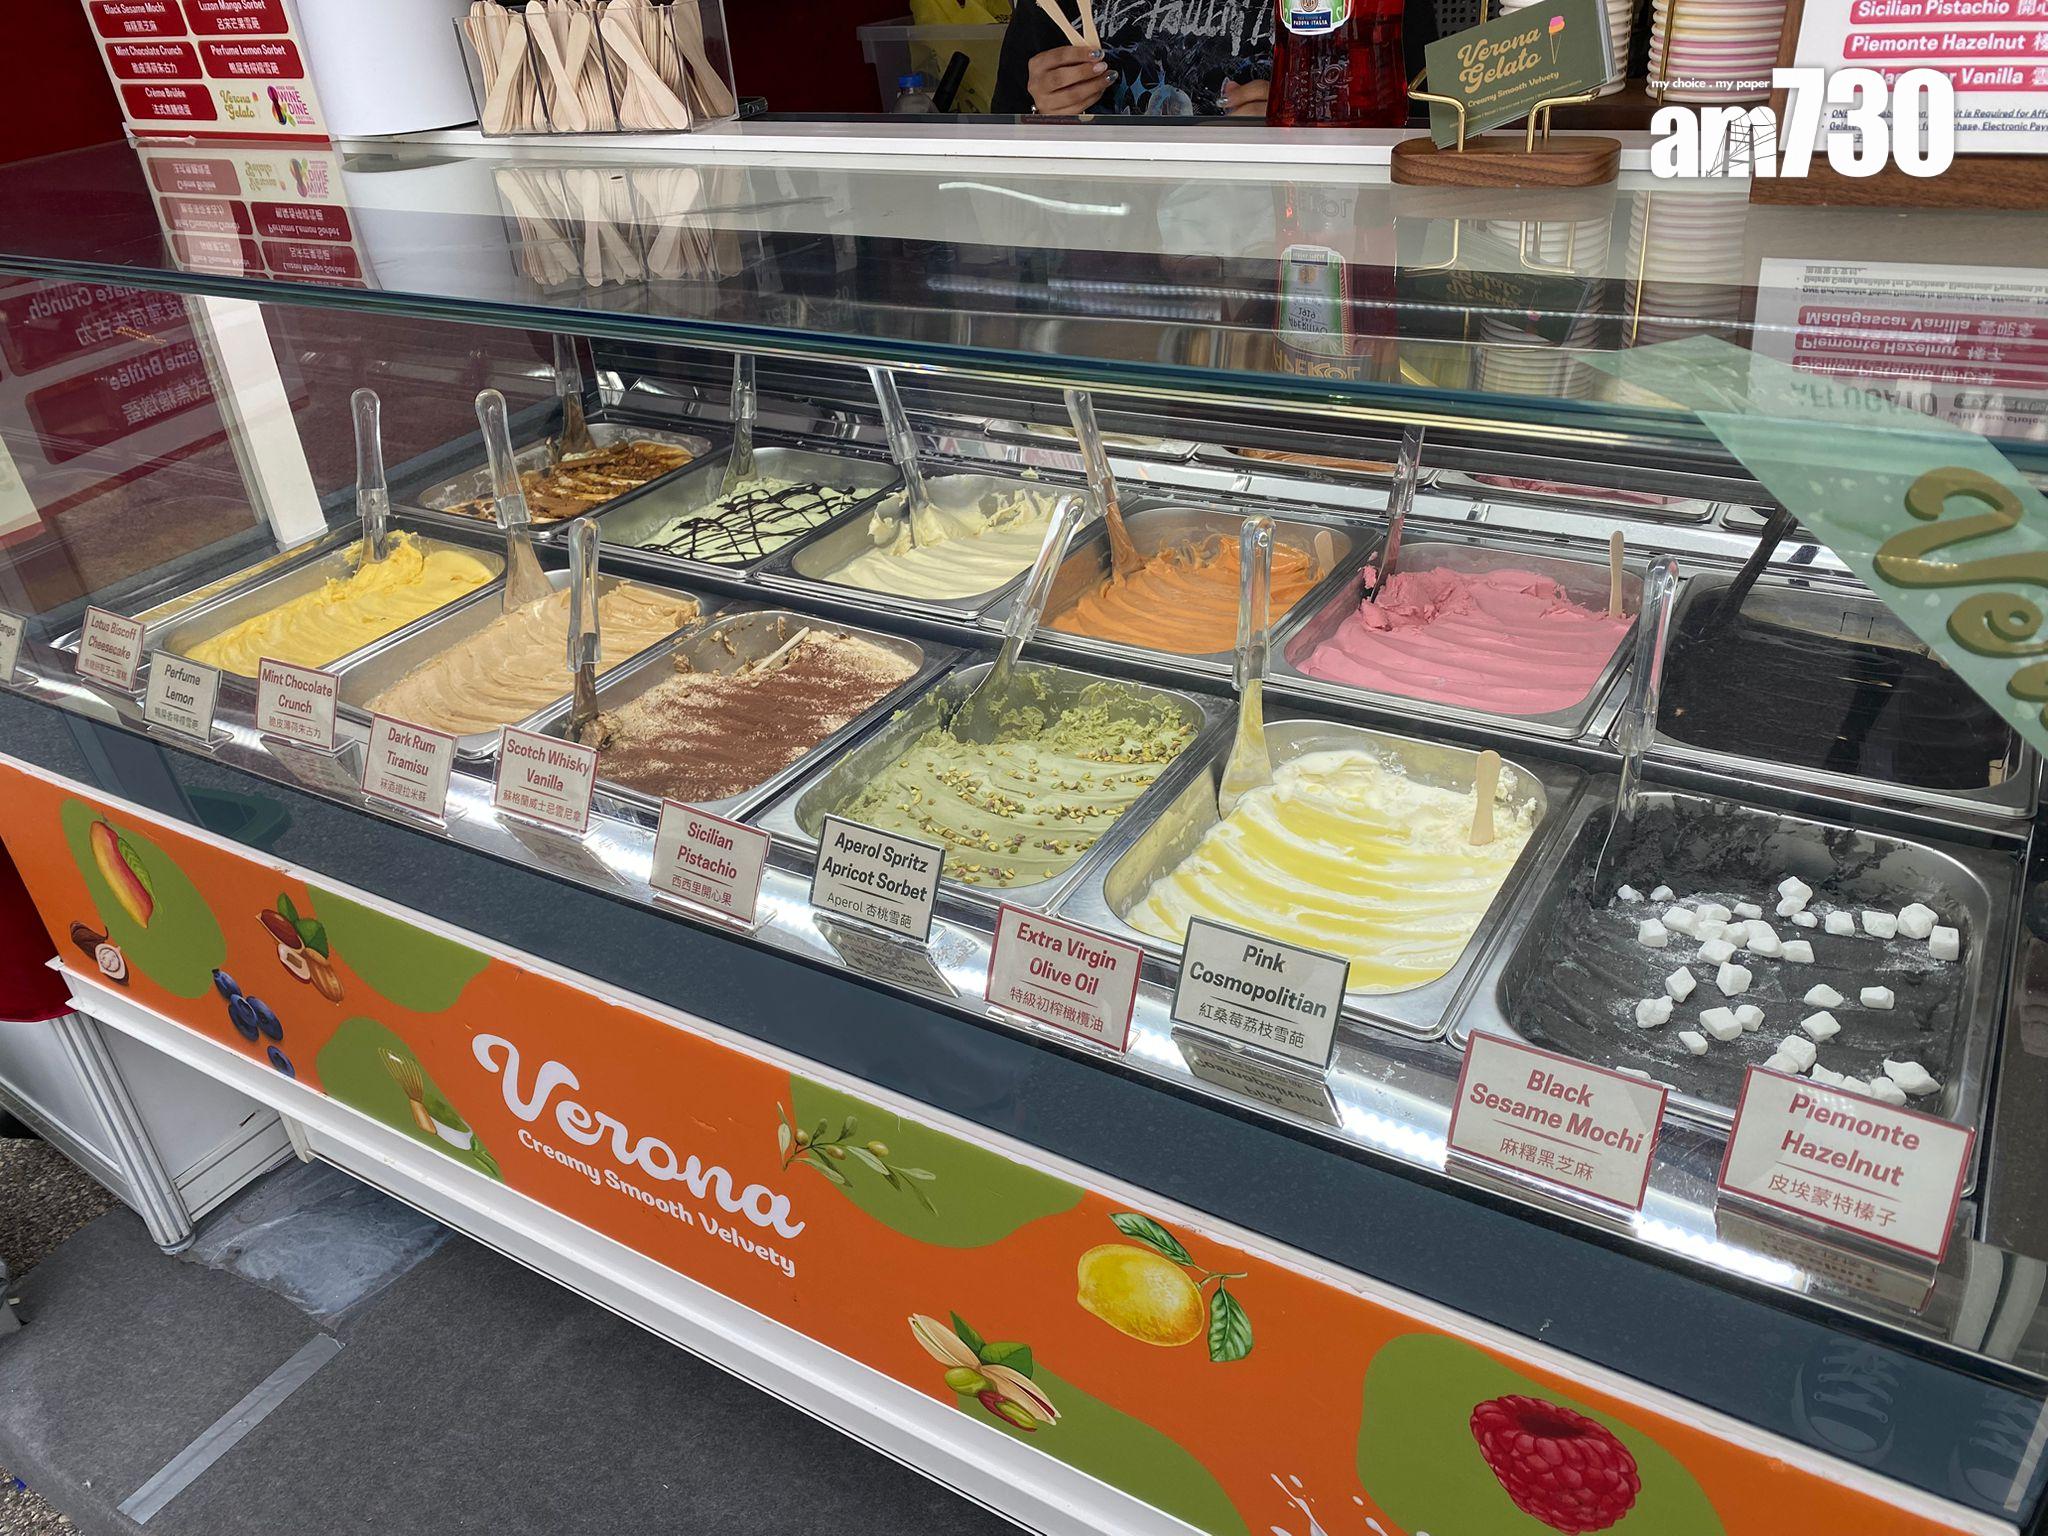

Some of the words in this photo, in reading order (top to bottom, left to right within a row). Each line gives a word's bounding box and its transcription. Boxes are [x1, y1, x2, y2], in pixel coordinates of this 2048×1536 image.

[103, 4, 120, 15] Black
[120, 3, 145, 14] Sesame
[145, 2, 165, 13] Mochi
[198, 0, 219, 11] Luzon
[219, 0, 241, 12] Mango
[242, 0, 266, 10] Sorbet
[1858, 0, 1921, 16] Sicilian
[1925, 0, 2010, 15] Pistachio
[114, 46, 130, 56] Mint
[129, 45, 159, 56] Chocolate
[159, 45, 183, 55] Crunch
[210, 44, 240, 55] Perfume
[239, 44, 261, 55] Lemon
[261, 44, 287, 55] Sorbet
[1457, 27, 1542, 68] Verona
[1851, 35, 1938, 52] Piemonte
[1942, 33, 2026, 50] Hazelnut
[1458, 48, 1542, 93] Gelato
[1961, 67, 2024, 85] Vanilla
[220, 90, 251, 104] Verona
[278, 91, 302, 103] WINE
[1467, 92, 1497, 107] Creamy
[1497, 82, 1528, 98] Smooth
[1529, 72, 1559, 86] Velvety
[225, 103, 256, 120] Gelato
[288, 103, 309, 115] DINE
[90, 615, 111, 633] Lotus
[110, 622, 137, 641] Biscoff
[88, 635, 131, 659] Cheesecake
[165, 664, 201, 686] Perfume
[262, 668, 284, 685] Mint
[285, 674, 333, 697] Chocolate
[165, 686, 194, 706] Lemon
[278, 694, 312, 714] Crunch
[387, 727, 412, 747] Dark
[411, 735, 436, 754] Rum
[387, 750, 429, 776] Tiramisu
[507, 738, 546, 762] Scotch
[547, 749, 590, 777] Whisky
[527, 768, 564, 792] Vanilla
[687, 821, 734, 850] Sicilian
[677, 845, 737, 879] Pistachio
[835, 832, 882, 859] Aperol
[882, 846, 929, 874] Spritz
[671, 873, 733, 907] 西西里開心果
[822, 856, 875, 886] Apricot
[876, 873, 928, 902] Sorbet
[827, 891, 863, 913] Aperol
[866, 903, 912, 929] 杏桃雪葩
[1017, 921, 1063, 952] Extra
[1066, 938, 1117, 971] Virgin
[1242, 944, 1286, 974] Pink
[1029, 957, 1072, 986] Olive
[1074, 973, 1100, 995] Oil
[1189, 961, 1327, 1019] Cosmopolitian
[1009, 986, 1104, 1033] 特級初榨橄欖油
[1198, 1002, 1305, 1049] 紅桑莓荔枝雪葩
[1526, 1069, 1595, 1108] Black
[1470, 1082, 1563, 1129] Sesame
[1565, 1112, 1645, 1154] Mochi
[1788, 1092, 1920, 1151] Piemonte
[472, 1033, 805, 1239] Verona
[1499, 1137, 1595, 1181] 麻糬黑芝麻
[1780, 1129, 1904, 1187] Hazelnut
[518, 1128, 602, 1186] Creamy
[604, 1168, 694, 1226] Smooth
[698, 1212, 797, 1278] Velvety
[1767, 1173, 1897, 1228] 皮埃蒙特榛子
